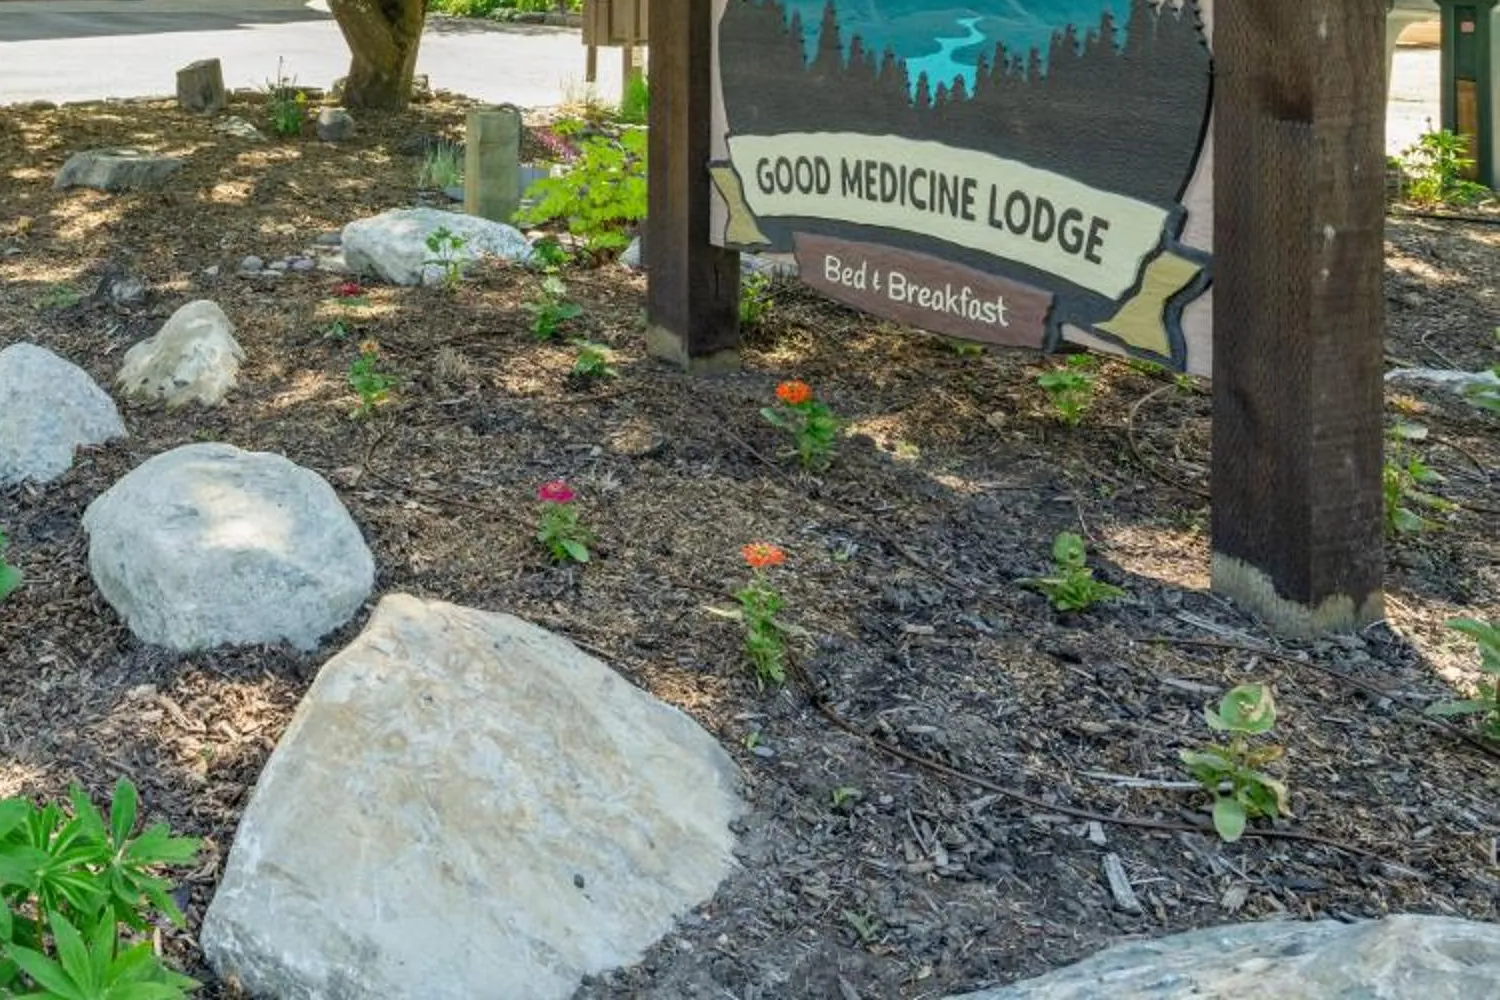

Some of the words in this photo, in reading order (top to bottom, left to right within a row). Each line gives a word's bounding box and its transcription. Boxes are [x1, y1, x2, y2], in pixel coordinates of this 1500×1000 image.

[756, 156, 830, 195] GOOD
[841, 159, 978, 221] MEDICINE
[988, 184, 1110, 264] LODGE
[824, 255, 867, 290] Bed
[888, 273, 1009, 326] Breakfast
